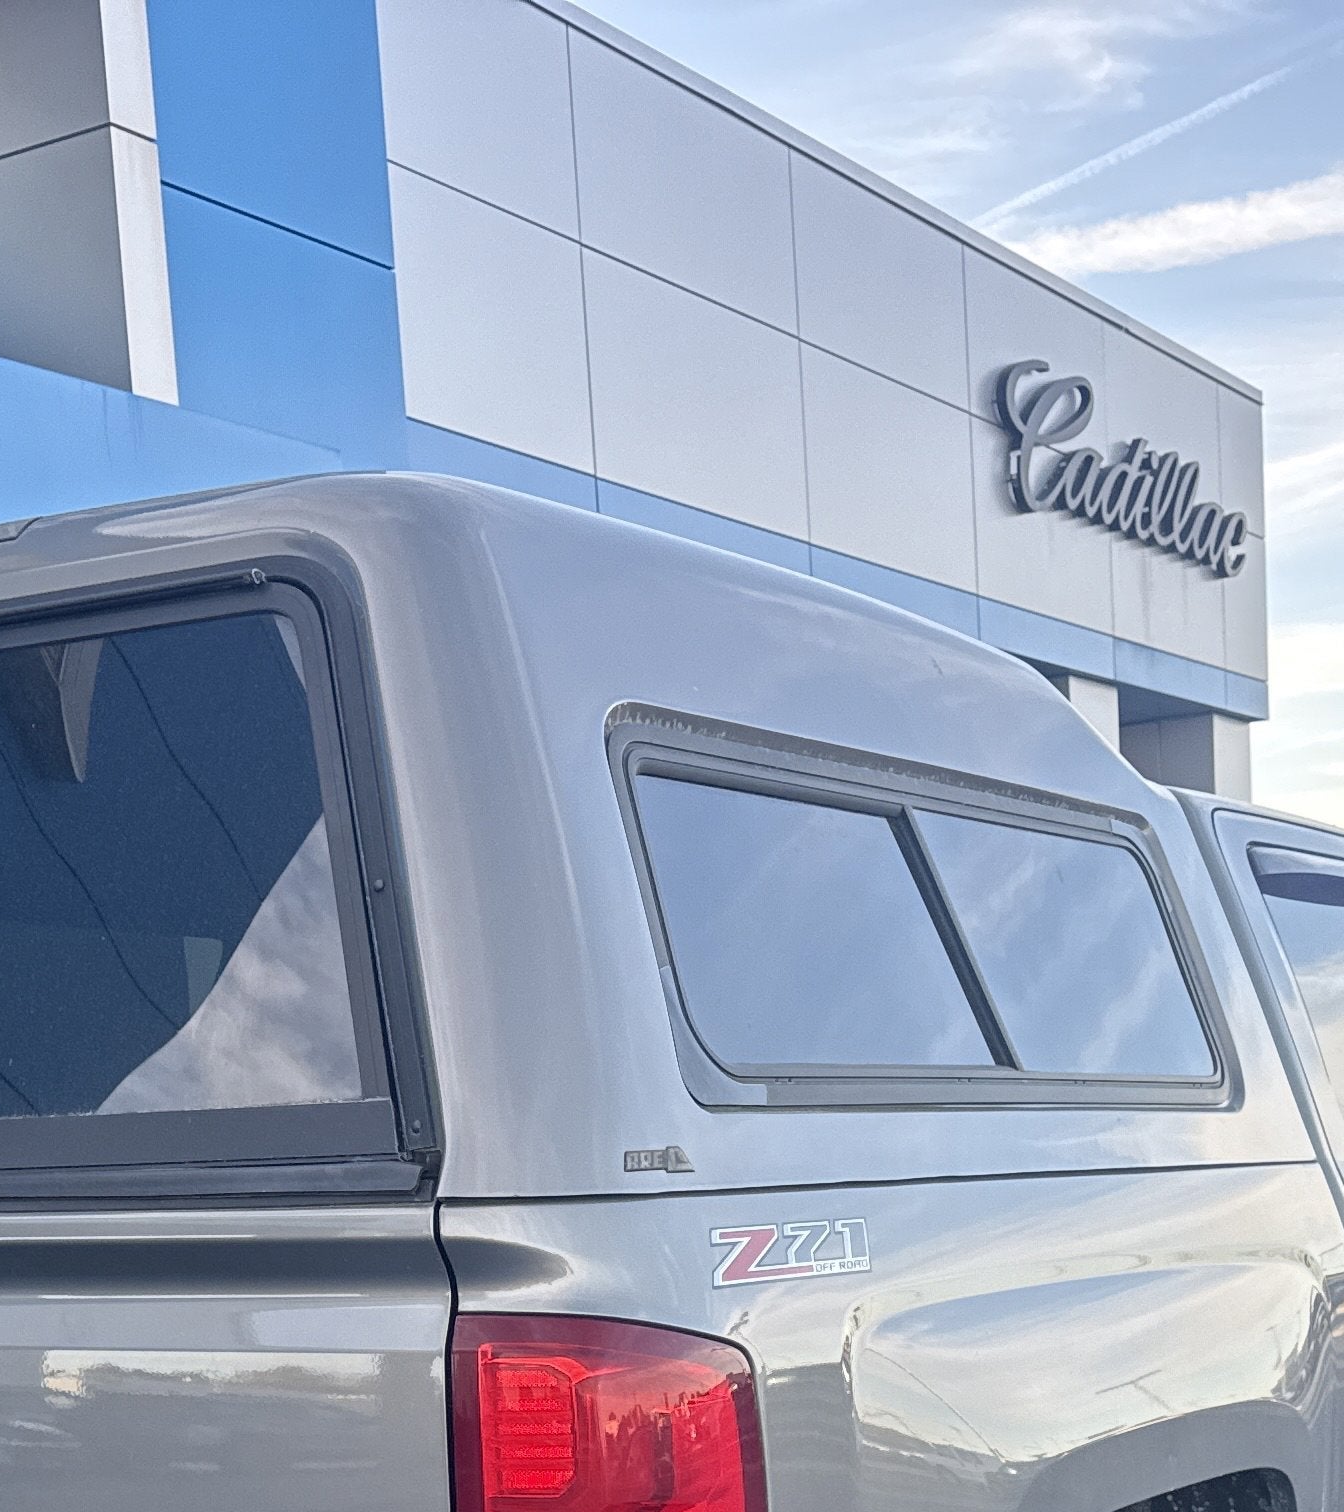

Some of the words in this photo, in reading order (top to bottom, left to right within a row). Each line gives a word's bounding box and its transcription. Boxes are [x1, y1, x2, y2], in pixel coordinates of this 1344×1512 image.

[994, 358, 1248, 577] Cadillac
[710, 1217, 871, 1288] Z71
[815, 1262, 836, 1272] OFF
[838, 1259, 868, 1271] ROAD
